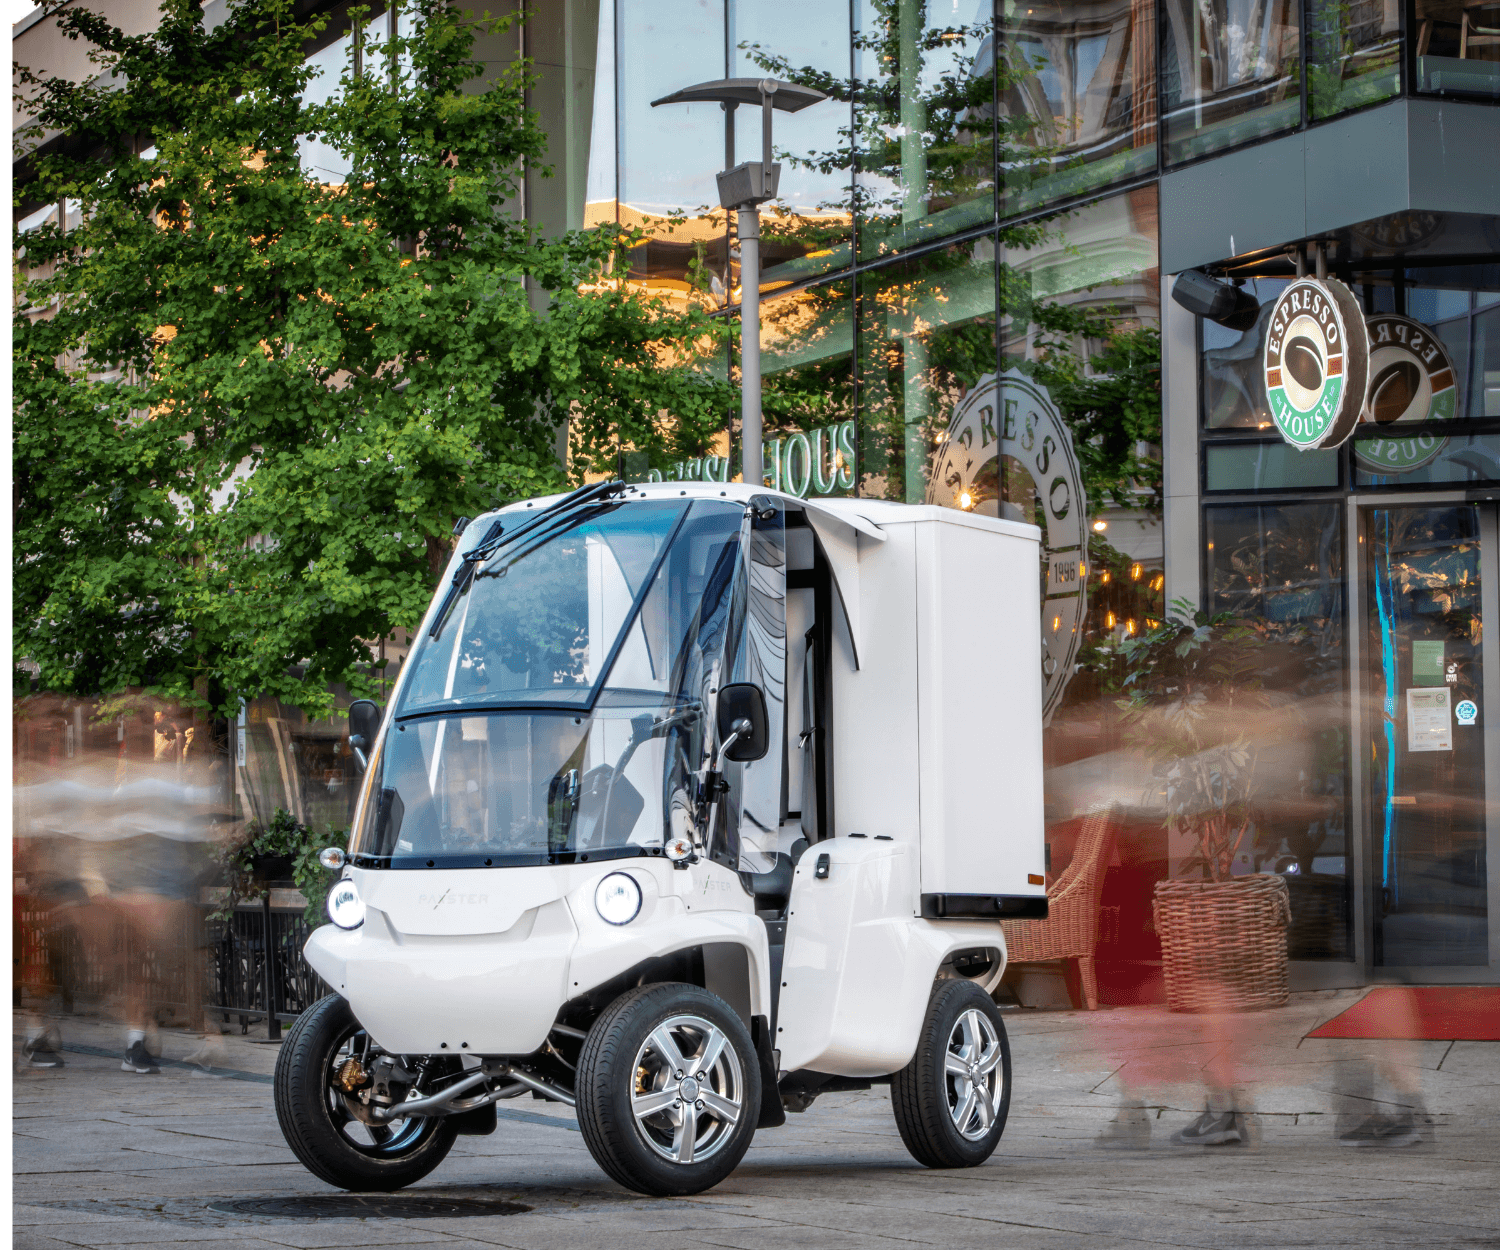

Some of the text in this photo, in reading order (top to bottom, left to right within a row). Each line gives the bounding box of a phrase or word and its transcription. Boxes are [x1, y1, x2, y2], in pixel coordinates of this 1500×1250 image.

[1268, 289, 1338, 356] ESPRESSO
[1277, 394, 1334, 438] HOUSE
[940, 398, 1070, 521] SPRESSO
[1053, 561, 1076, 583] 1996
